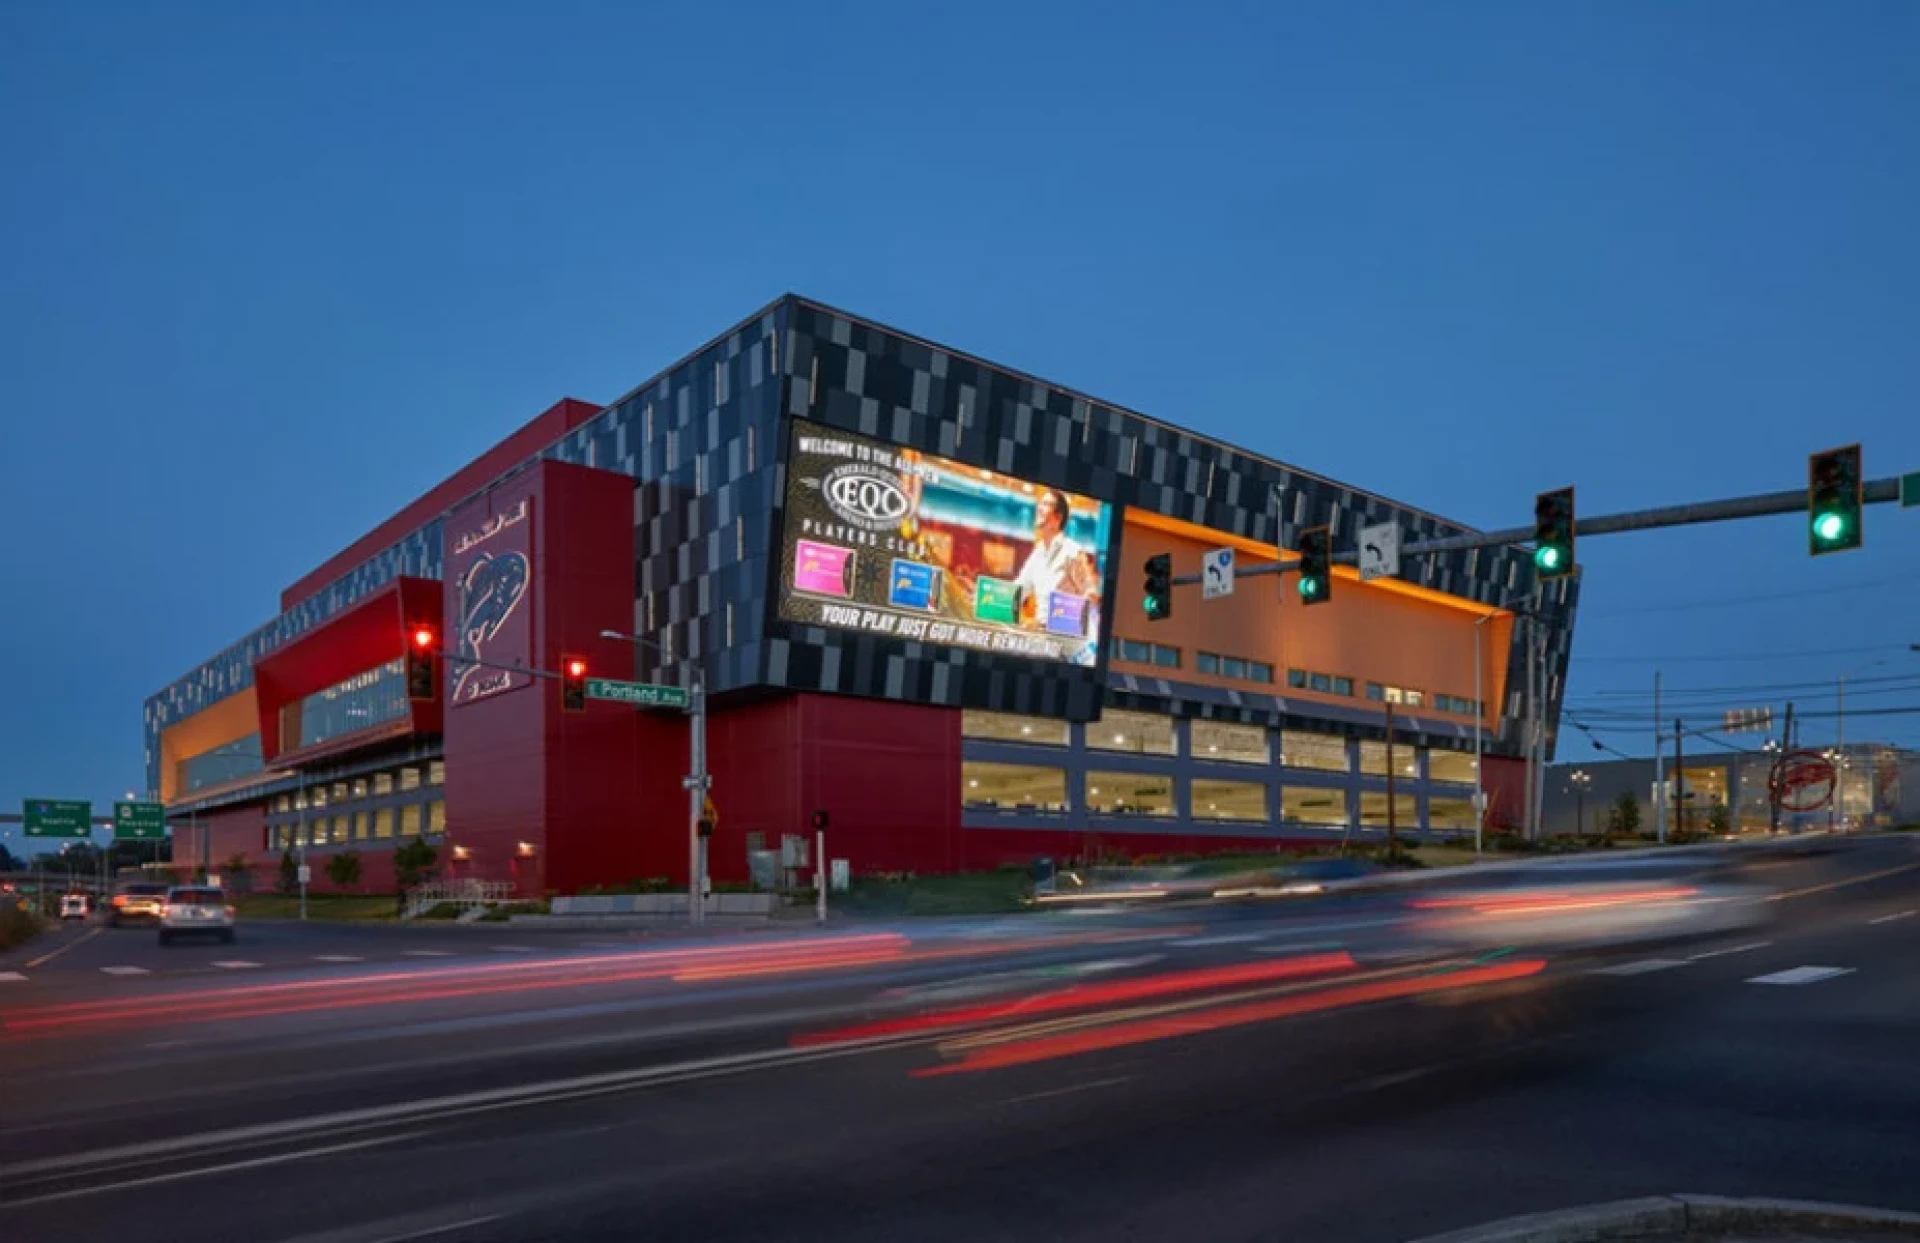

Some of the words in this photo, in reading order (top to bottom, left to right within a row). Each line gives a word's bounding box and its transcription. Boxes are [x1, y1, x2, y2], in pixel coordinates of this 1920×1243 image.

[799, 437, 853, 458] WELCOME
[857, 444, 870, 460] TO
[873, 448, 892, 466] THE
[844, 479, 907, 518] EQC
[803, 519, 877, 546] PLAYERS
[888, 537, 925, 556] CLUB
[822, 605, 860, 625] YOUR
[861, 611, 897, 631] PLAY
[896, 617, 928, 638] JUST
[929, 623, 956, 641] GOT
[956, 627, 992, 646] MORE
[603, 682, 658, 702] Portland
[663, 691, 683, 704] Ave
